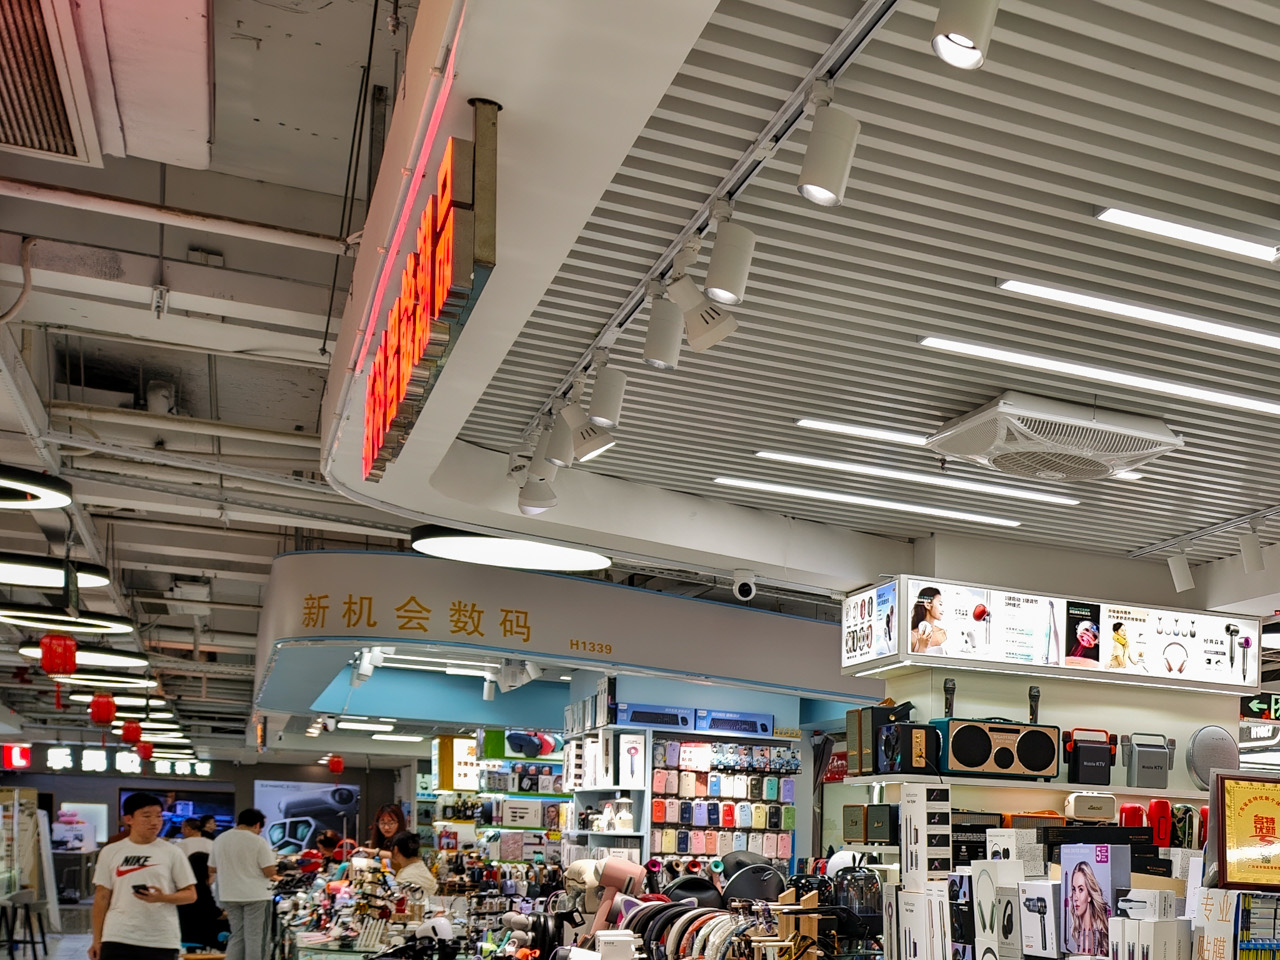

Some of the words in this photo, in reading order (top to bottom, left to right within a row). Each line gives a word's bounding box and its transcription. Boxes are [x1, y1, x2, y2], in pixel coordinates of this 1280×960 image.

[302, 593, 531, 643] 新机会数码
[569, 639, 612, 655] H1339
[1254, 813, 1276, 826] 名特
[1254, 825, 1276, 836] 优新
[1096, 847, 1101, 861] 5
[120, 856, 152, 867] NIKE
[1201, 893, 1232, 923] 专业
